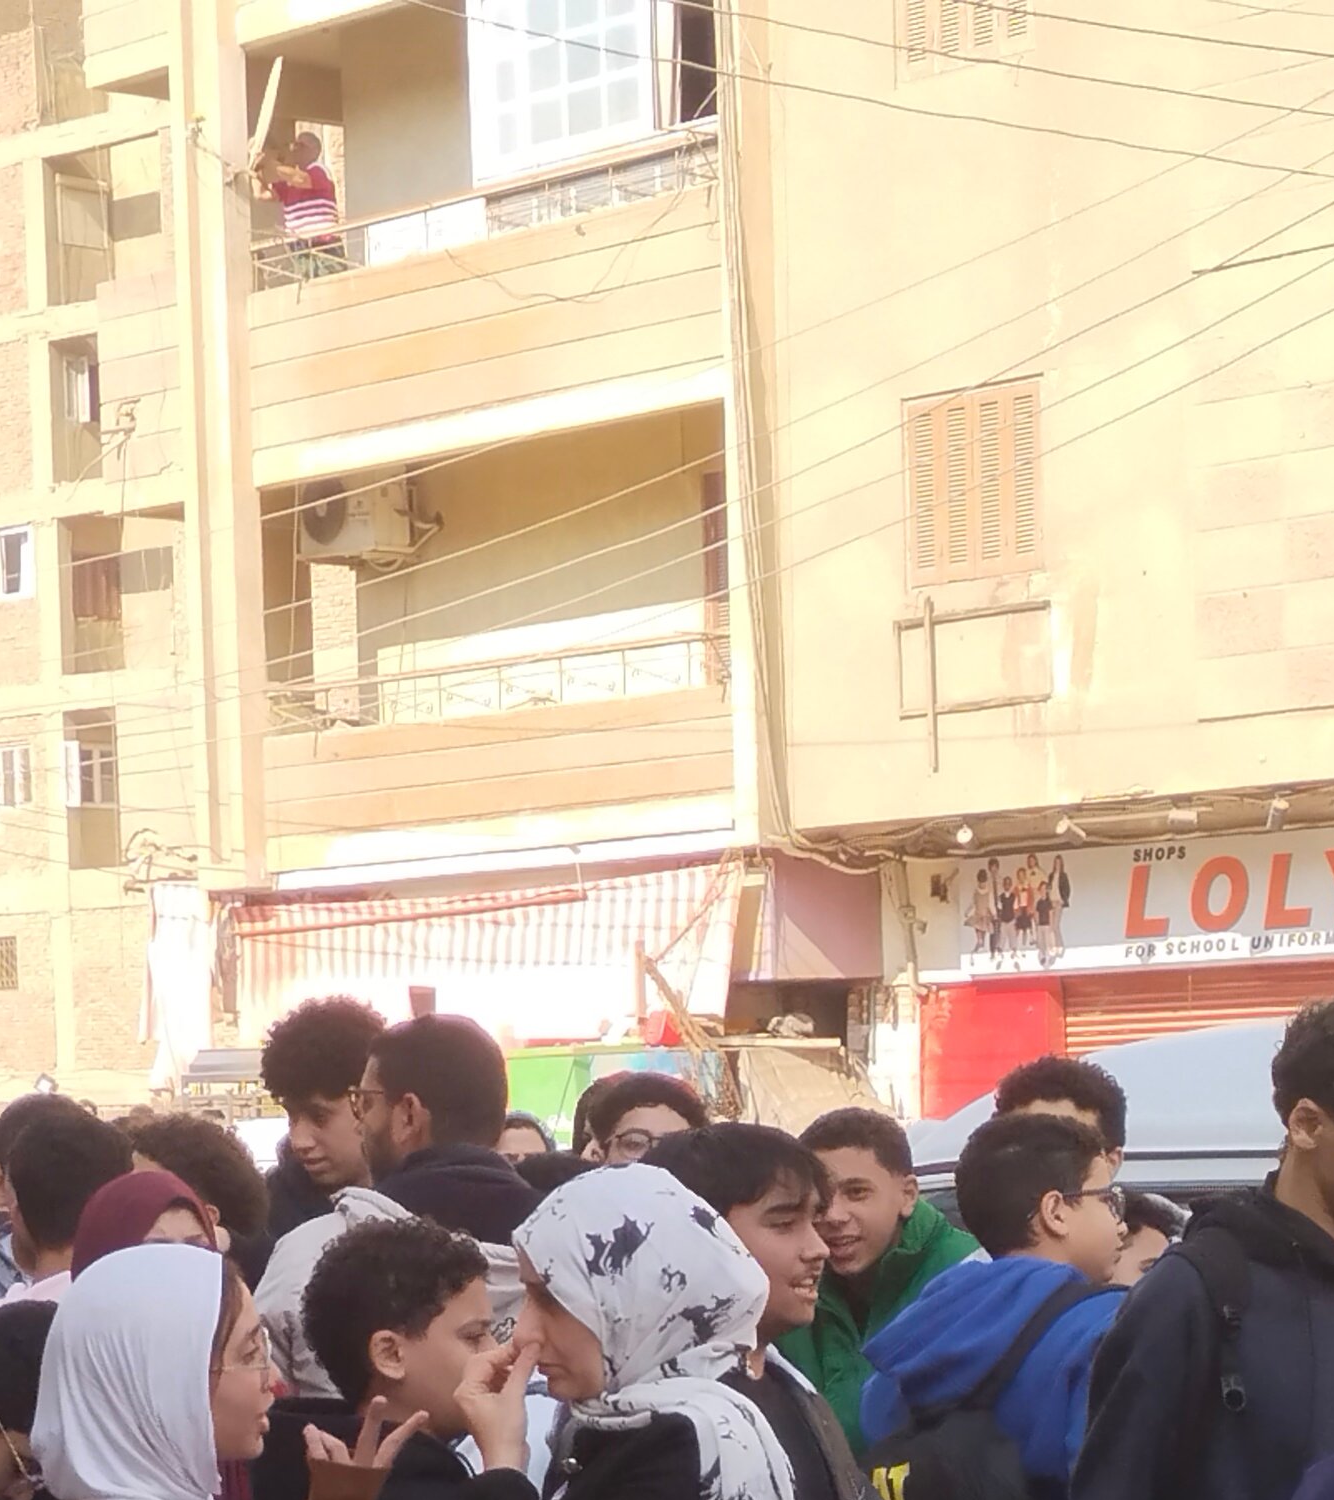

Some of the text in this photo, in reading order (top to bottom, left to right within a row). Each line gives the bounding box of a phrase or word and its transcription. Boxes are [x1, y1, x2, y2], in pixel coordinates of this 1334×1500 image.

[1133, 846, 1187, 862] SHOPS
[1125, 942, 1157, 958] FOR
[1165, 937, 1240, 956] SCHOOL
